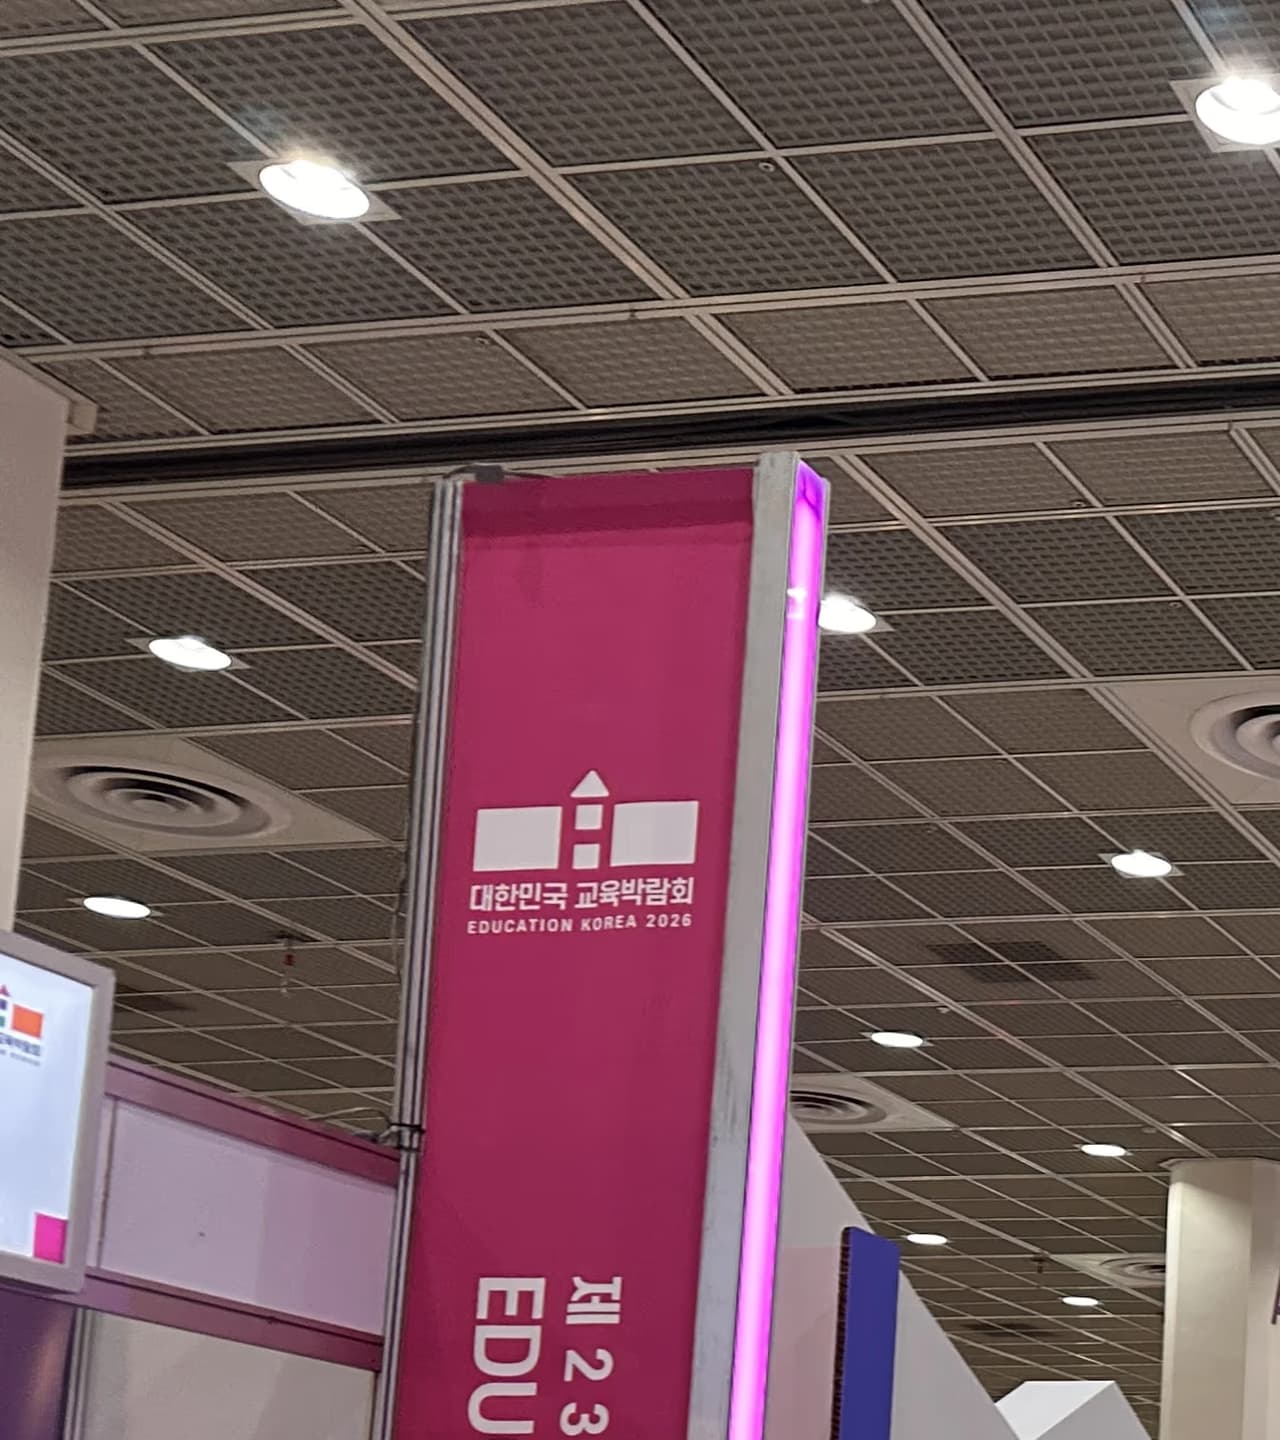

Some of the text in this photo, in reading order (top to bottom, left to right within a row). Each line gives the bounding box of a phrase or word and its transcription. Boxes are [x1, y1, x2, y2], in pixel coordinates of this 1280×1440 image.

[470, 877, 694, 912] 대한민국 교육박람회
[466, 914, 693, 934] EDUCATION KOREA 2026
